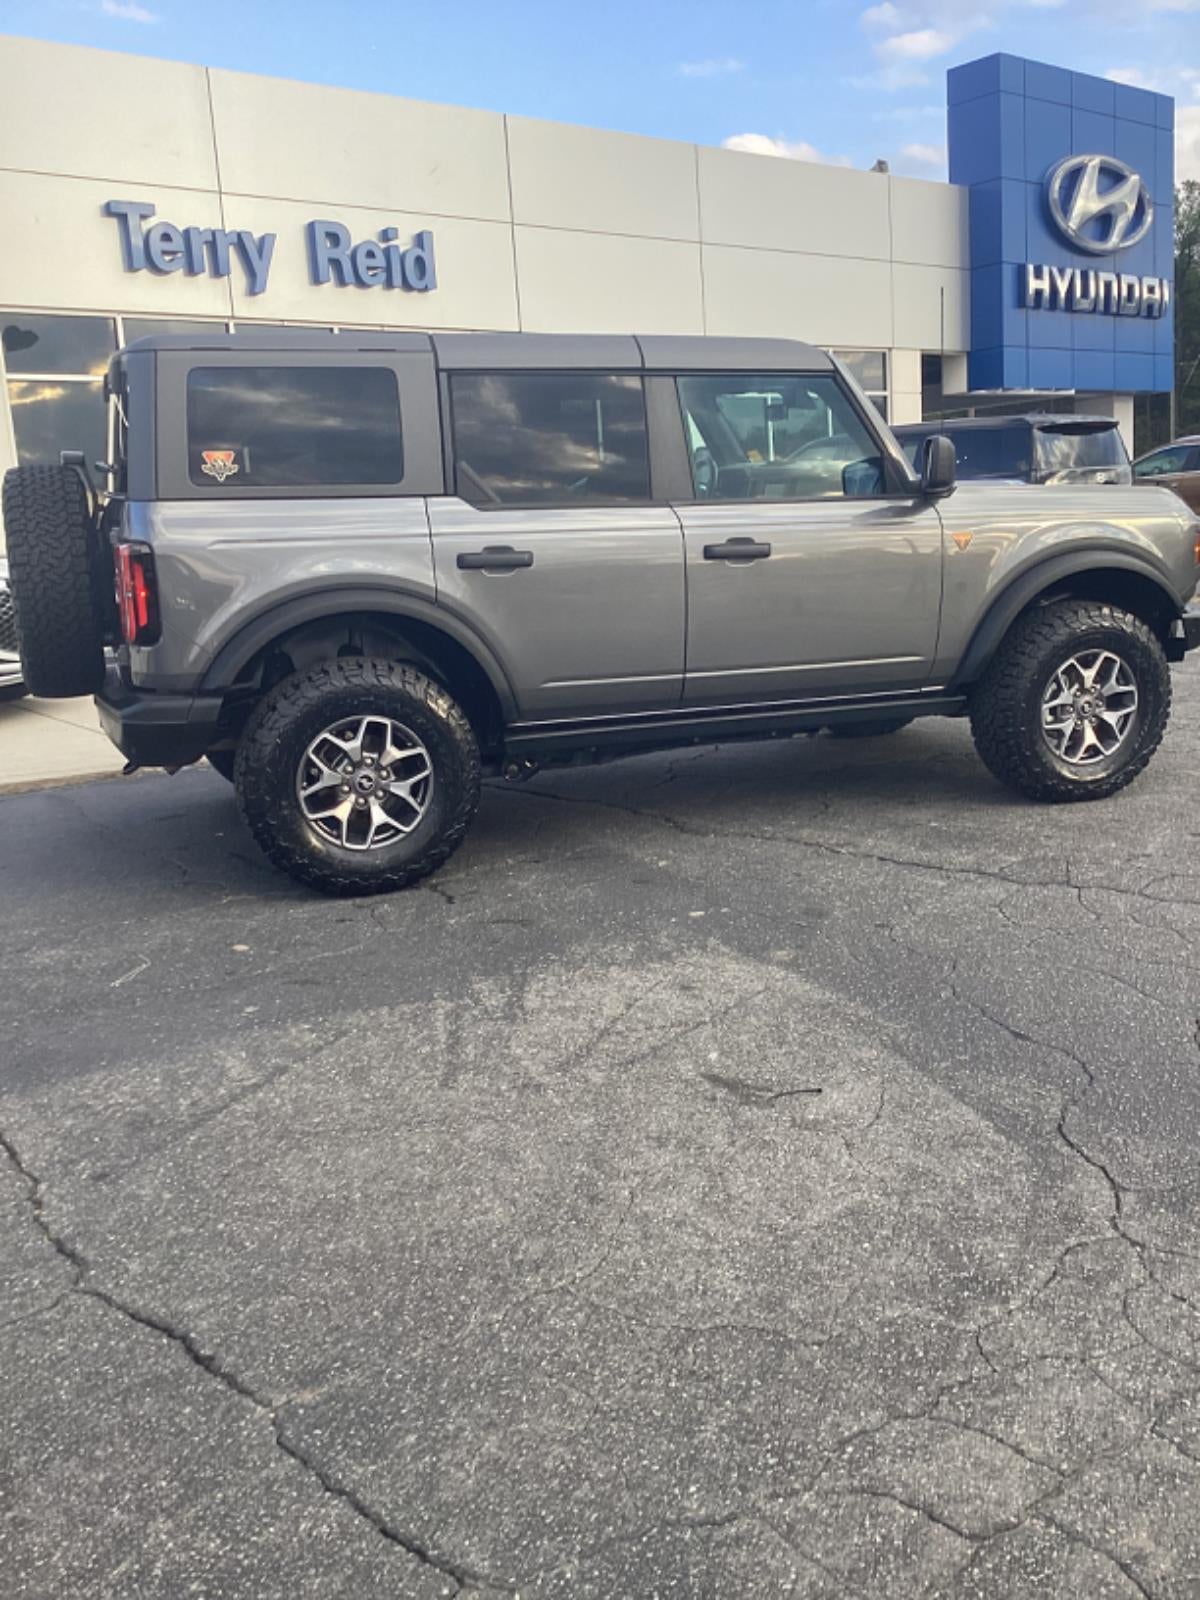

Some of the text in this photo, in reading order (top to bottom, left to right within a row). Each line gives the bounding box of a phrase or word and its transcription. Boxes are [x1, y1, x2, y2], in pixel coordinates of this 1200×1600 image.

[104, 199, 437, 296] Terry Reid
[1021, 263, 1170, 319] HYUNDAI
